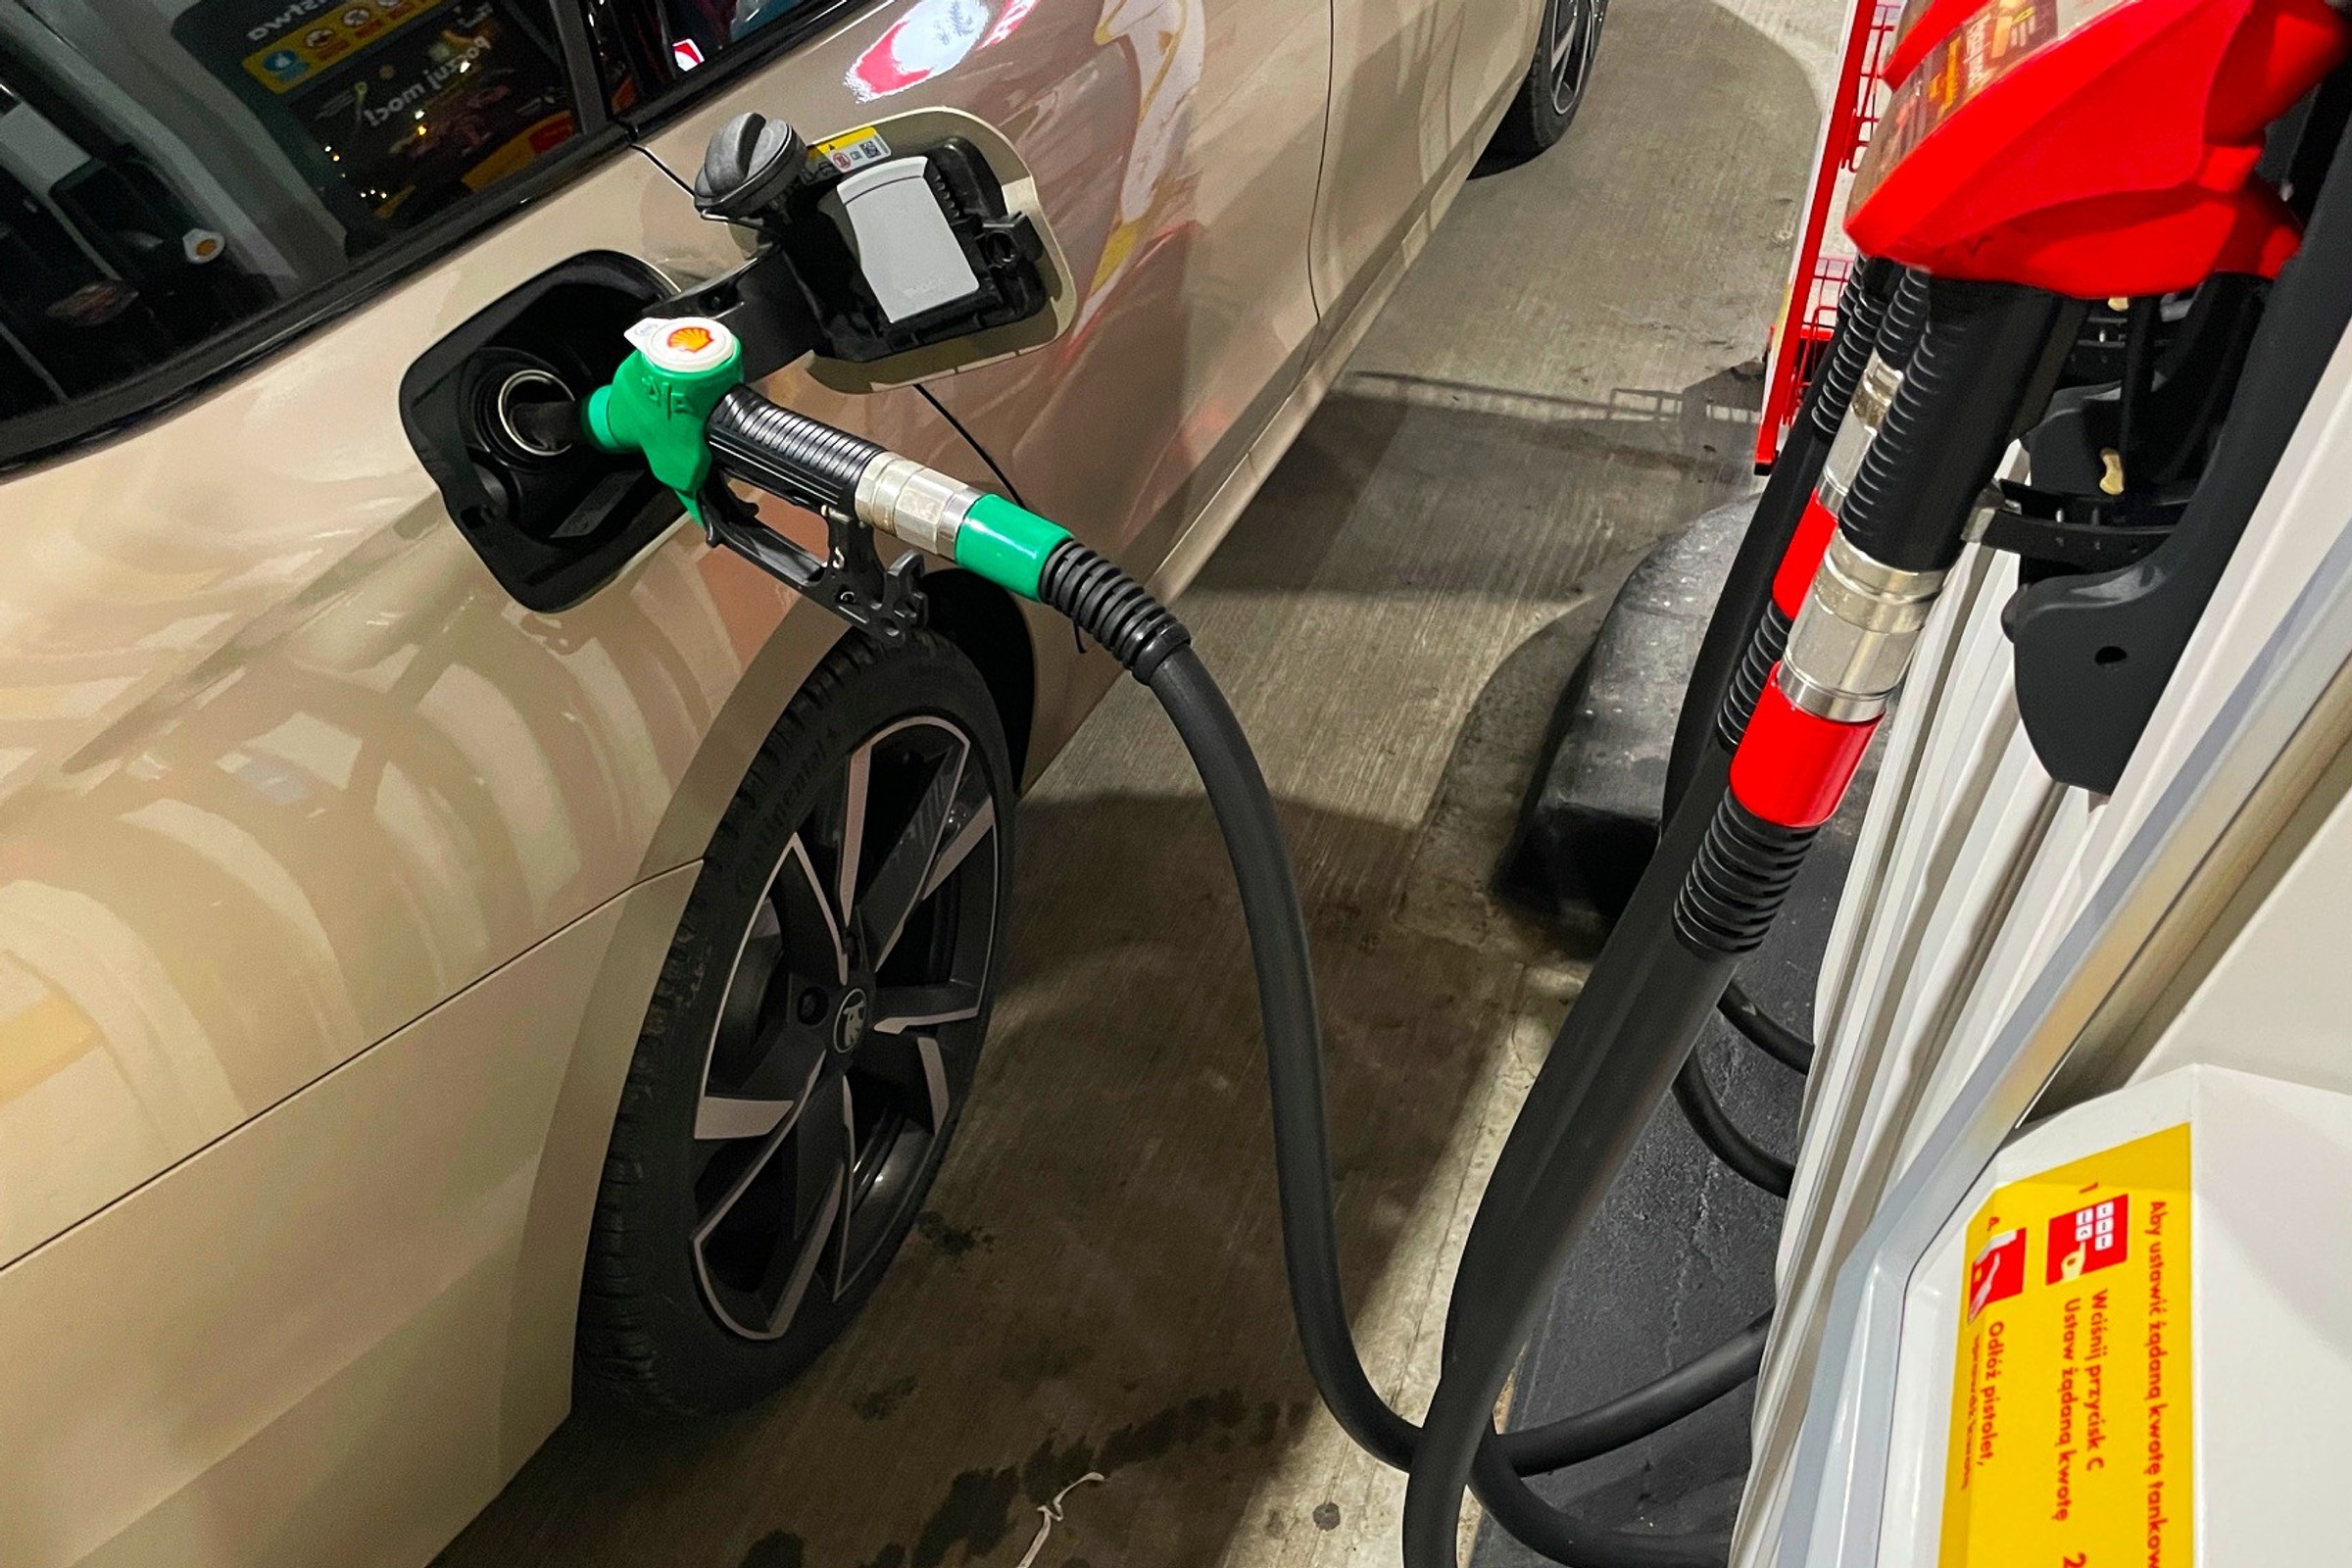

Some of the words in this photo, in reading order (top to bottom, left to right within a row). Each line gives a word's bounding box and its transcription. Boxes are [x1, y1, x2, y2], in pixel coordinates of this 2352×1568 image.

[2144, 1201, 2169, 1236] Aby
[2148, 1241, 2168, 1318] ustawić
[1984, 1321, 2005, 1382] Odłóż
[2063, 1298, 2082, 1361] Ustaw
[2083, 1289, 2108, 1361] Wciśnij
[2143, 1322, 2168, 1401] żądaną
[1975, 1385, 2001, 1467] pistolet,
[2054, 1367, 2079, 1447] żądaną
[2082, 1364, 2106, 1452] przycisk
[2143, 1403, 2169, 1476] kwotę
[2050, 1449, 2078, 1522] kwotę
[2086, 1457, 2104, 1471] C
[2063, 1552, 2087, 1568] 2
